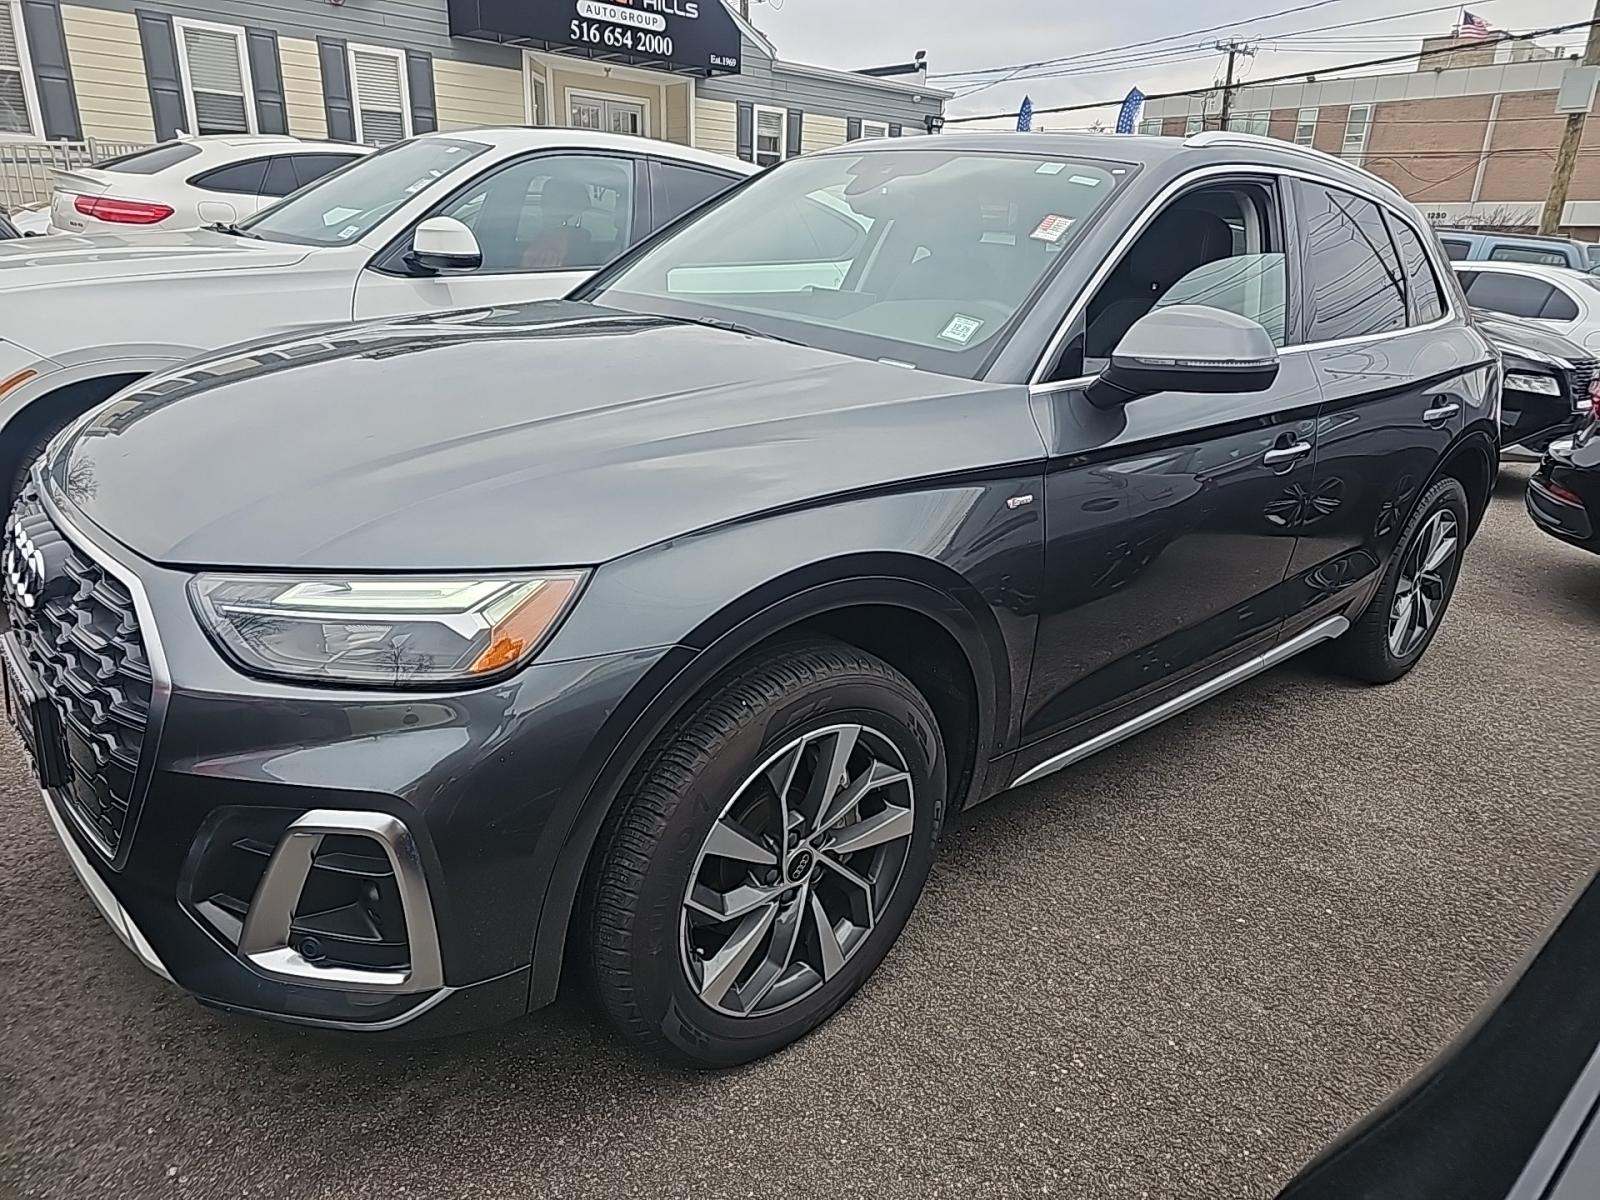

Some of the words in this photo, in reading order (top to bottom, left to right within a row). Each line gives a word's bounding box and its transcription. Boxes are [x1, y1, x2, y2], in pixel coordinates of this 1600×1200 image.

[585, 4, 617, 18] AUTO
[620, 11, 658, 26] GROUP
[570, 20, 600, 43] 516
[603, 26, 633, 49] 654
[636, 32, 673, 56] 2000
